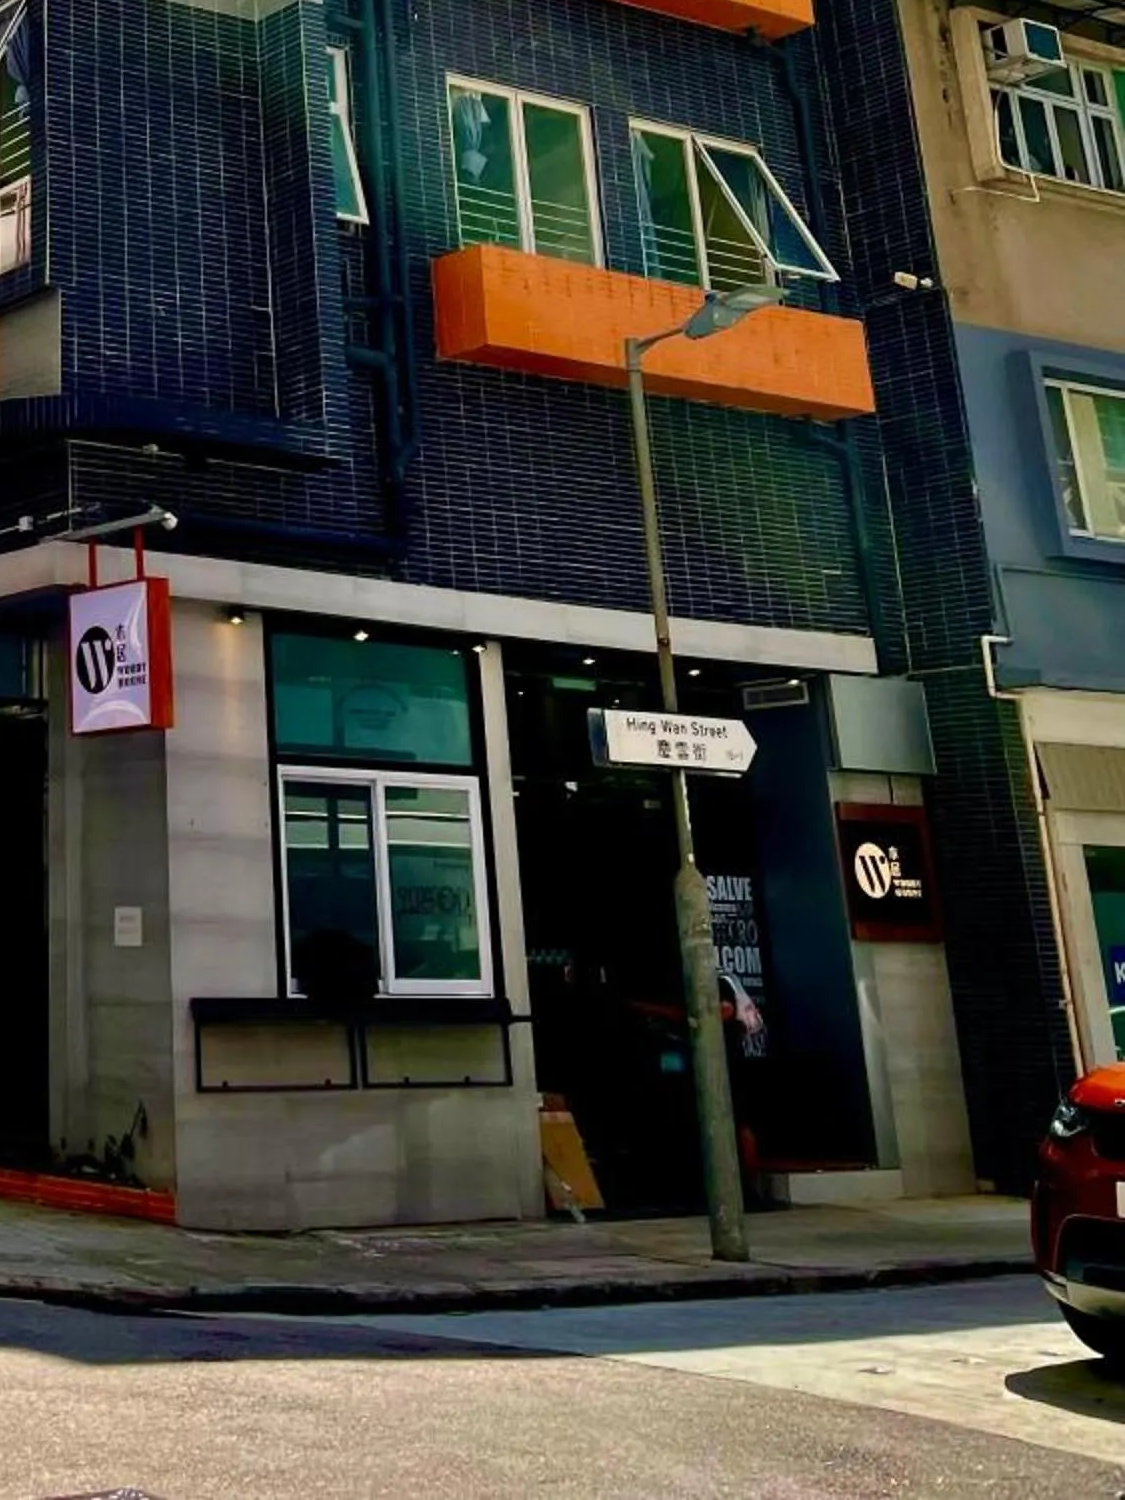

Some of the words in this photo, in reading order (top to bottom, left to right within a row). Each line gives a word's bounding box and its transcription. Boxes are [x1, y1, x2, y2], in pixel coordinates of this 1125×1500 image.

[627, 717, 656, 735] Hing
[660, 719, 688, 735] Wan
[690, 721, 728, 739] Street
[706, 875, 752, 901] SALVE
